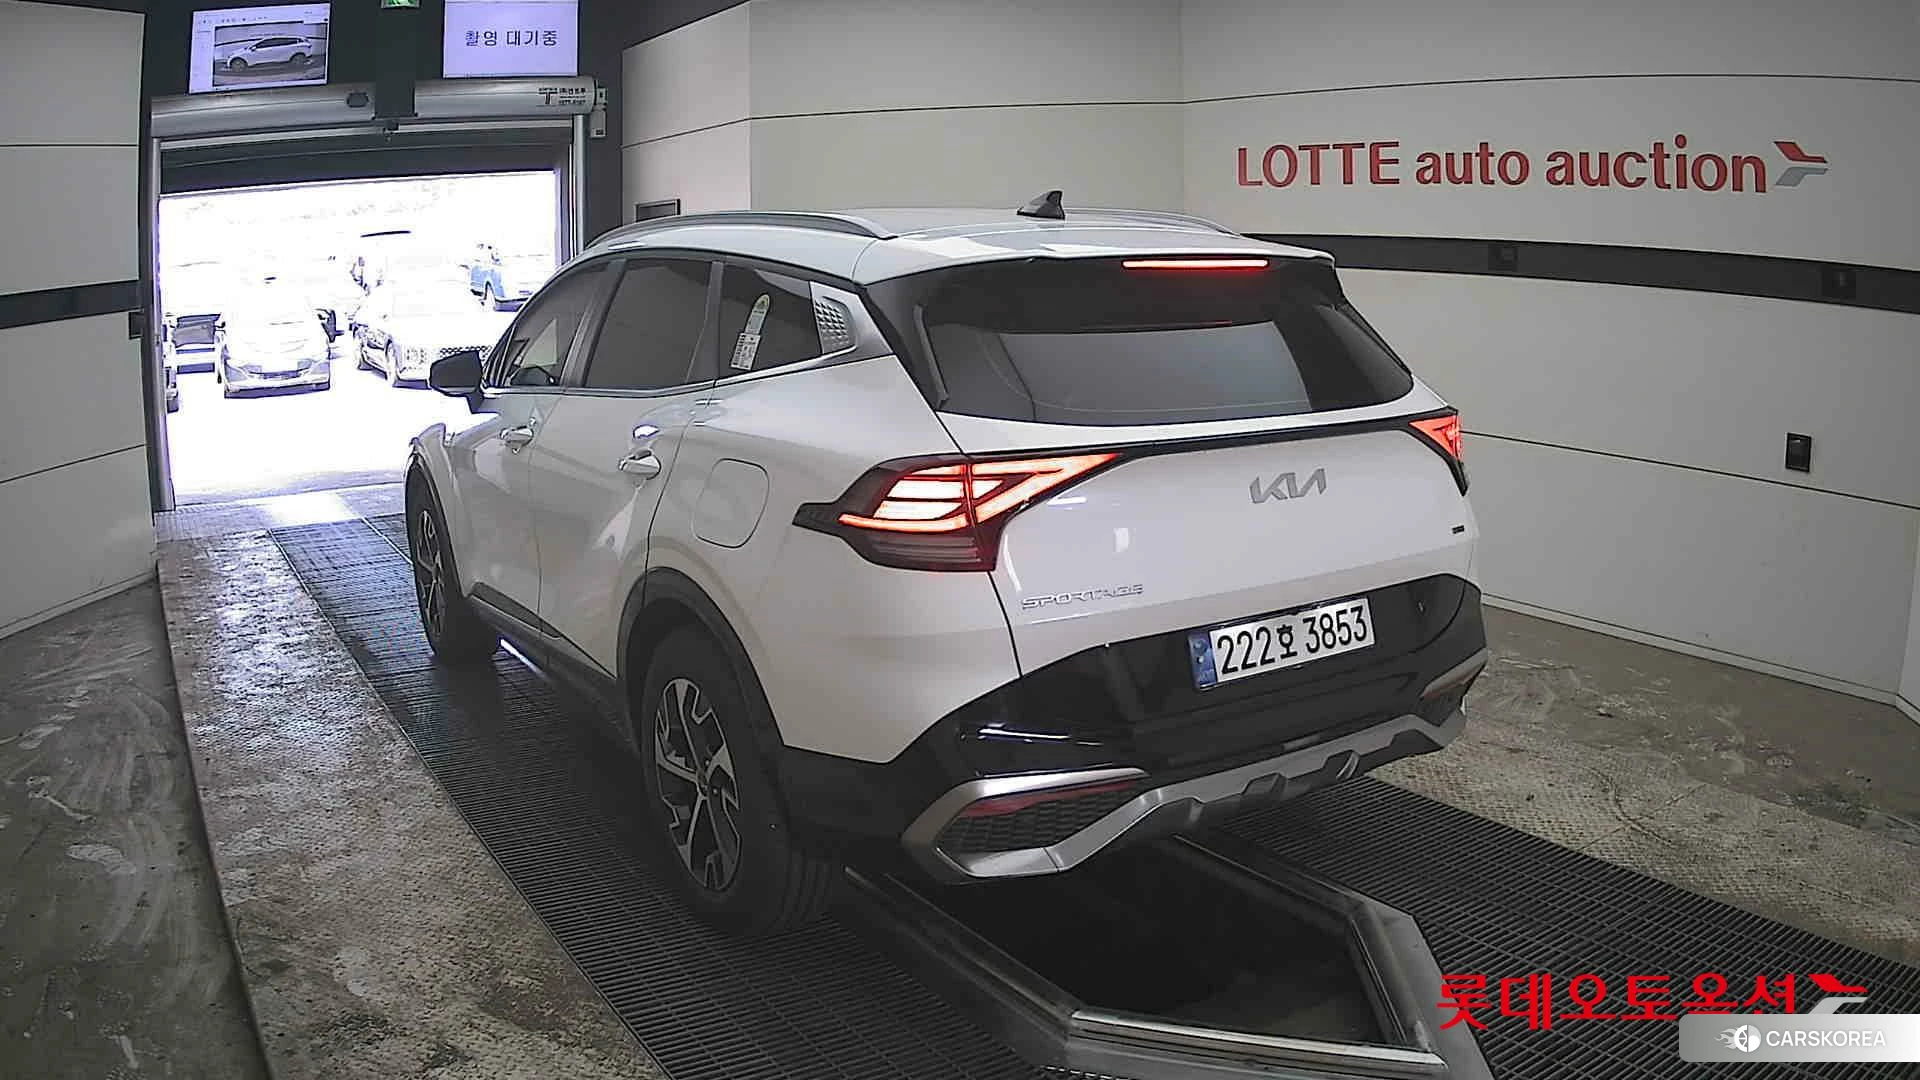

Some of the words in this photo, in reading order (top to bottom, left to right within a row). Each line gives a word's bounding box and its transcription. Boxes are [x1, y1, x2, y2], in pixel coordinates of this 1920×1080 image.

[506, 30, 558, 46] 대기중
[1238, 141, 1400, 188] LOTTE
[1415, 142, 1530, 186] auto
[1544, 134, 1767, 193] auction
[1249, 468, 1327, 504] KIA
[1217, 623, 1298, 675] 222호
[1302, 605, 1368, 654] 3853
